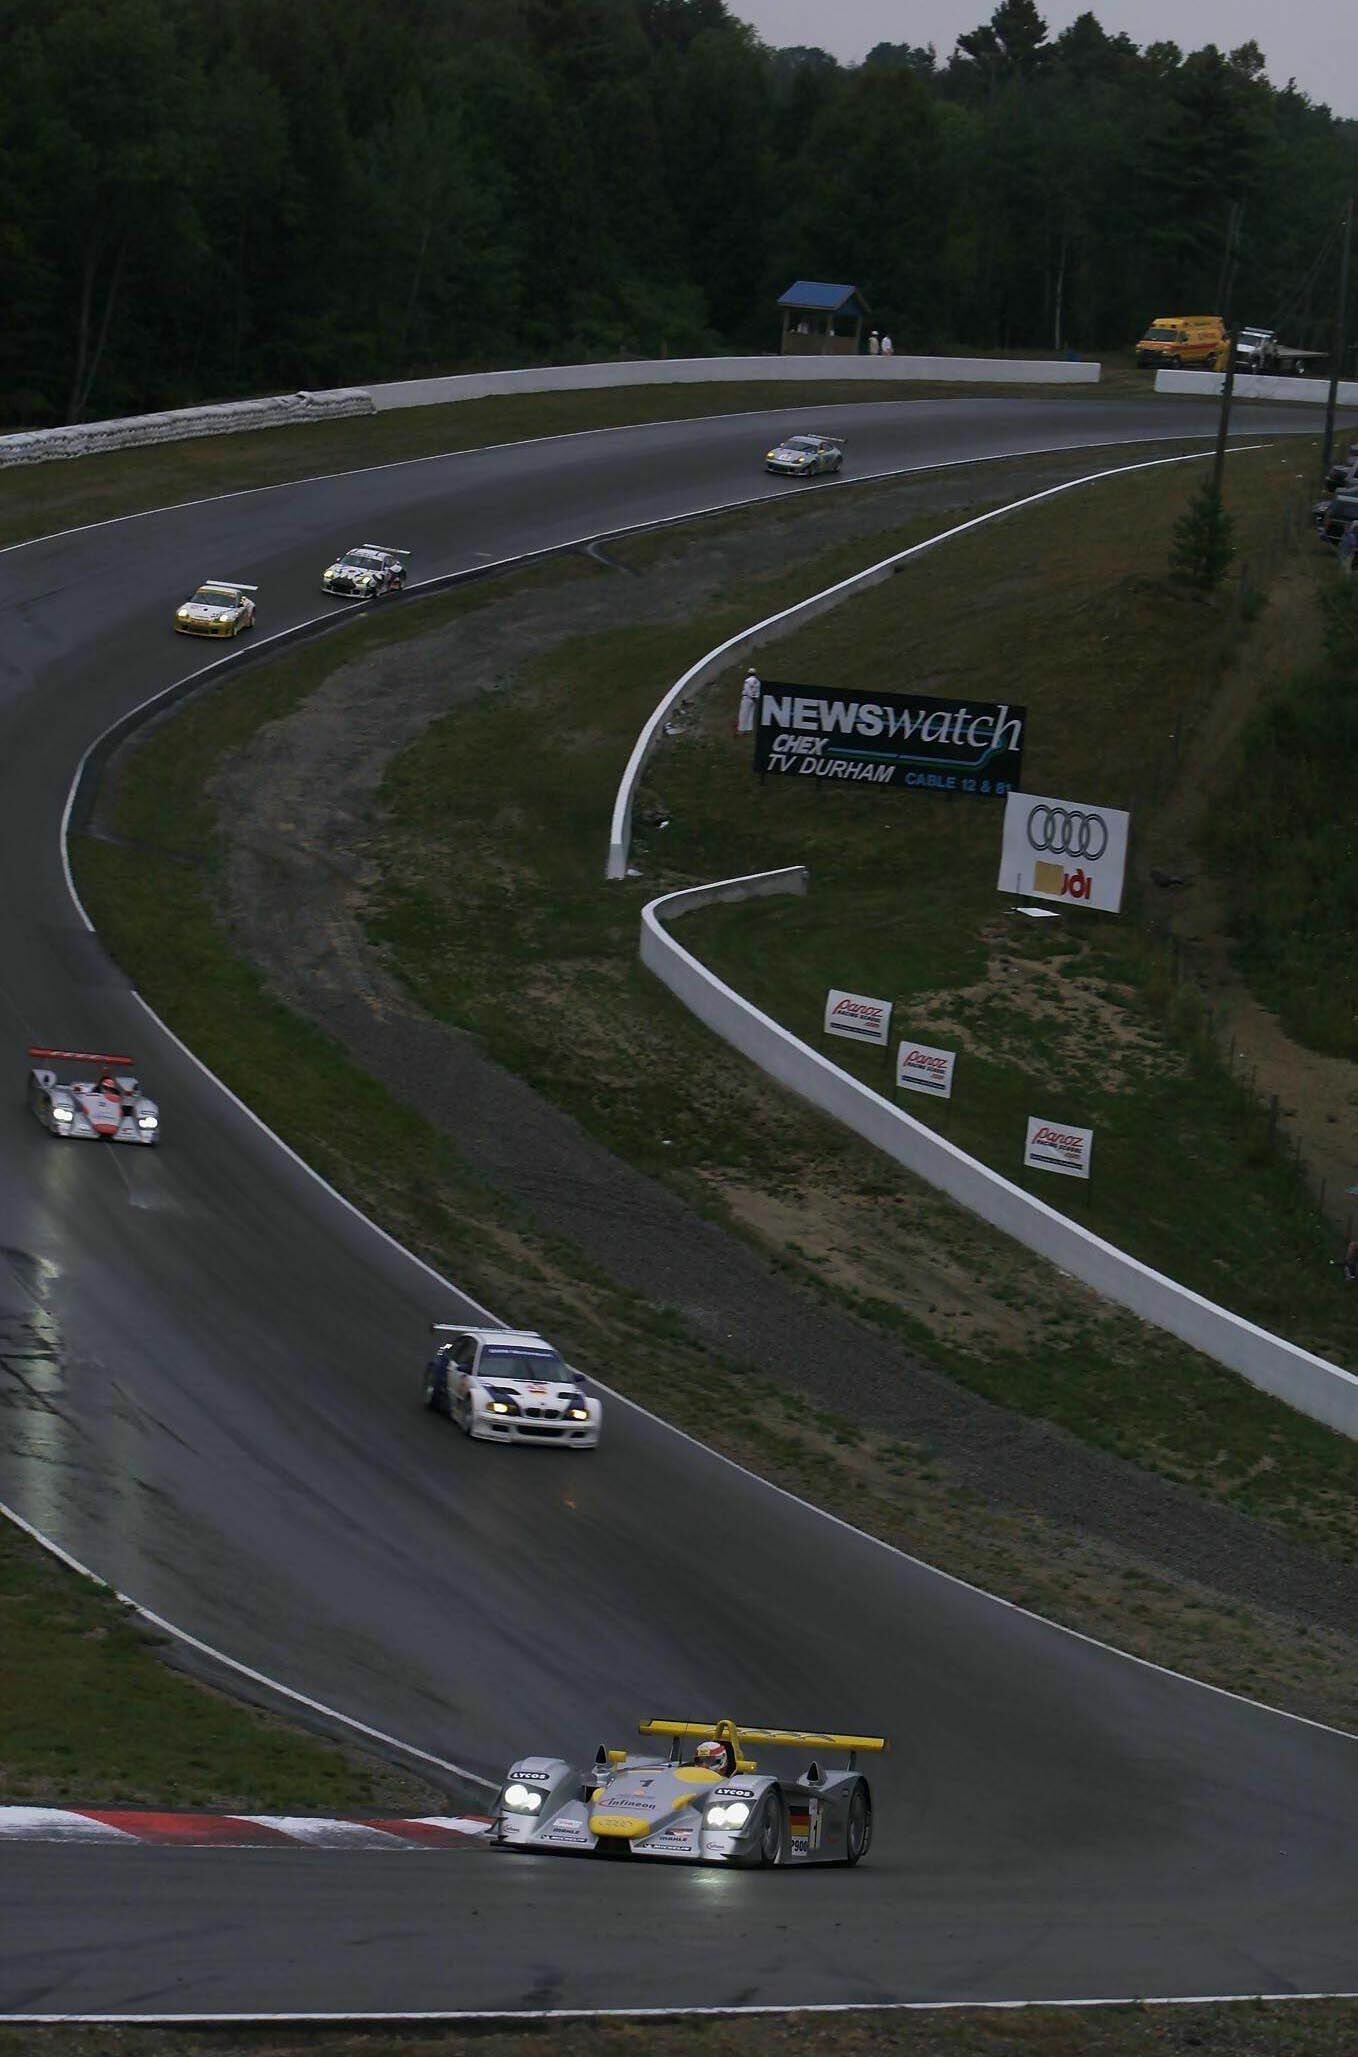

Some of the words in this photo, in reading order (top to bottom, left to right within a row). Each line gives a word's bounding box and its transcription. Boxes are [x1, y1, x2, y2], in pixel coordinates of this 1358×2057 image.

[772, 734, 829, 755] CHEX
[767, 753, 797, 772] TV
[798, 757, 897, 783] DURHAM
[905, 772, 957, 789] CABLE
[962, 779, 977, 792] 12
[981, 780, 991, 793] &
[512, 1772, 546, 1780] LYCOS
[717, 1788, 751, 1797] LYCOS
[607, 1798, 656, 1811] Infineon
